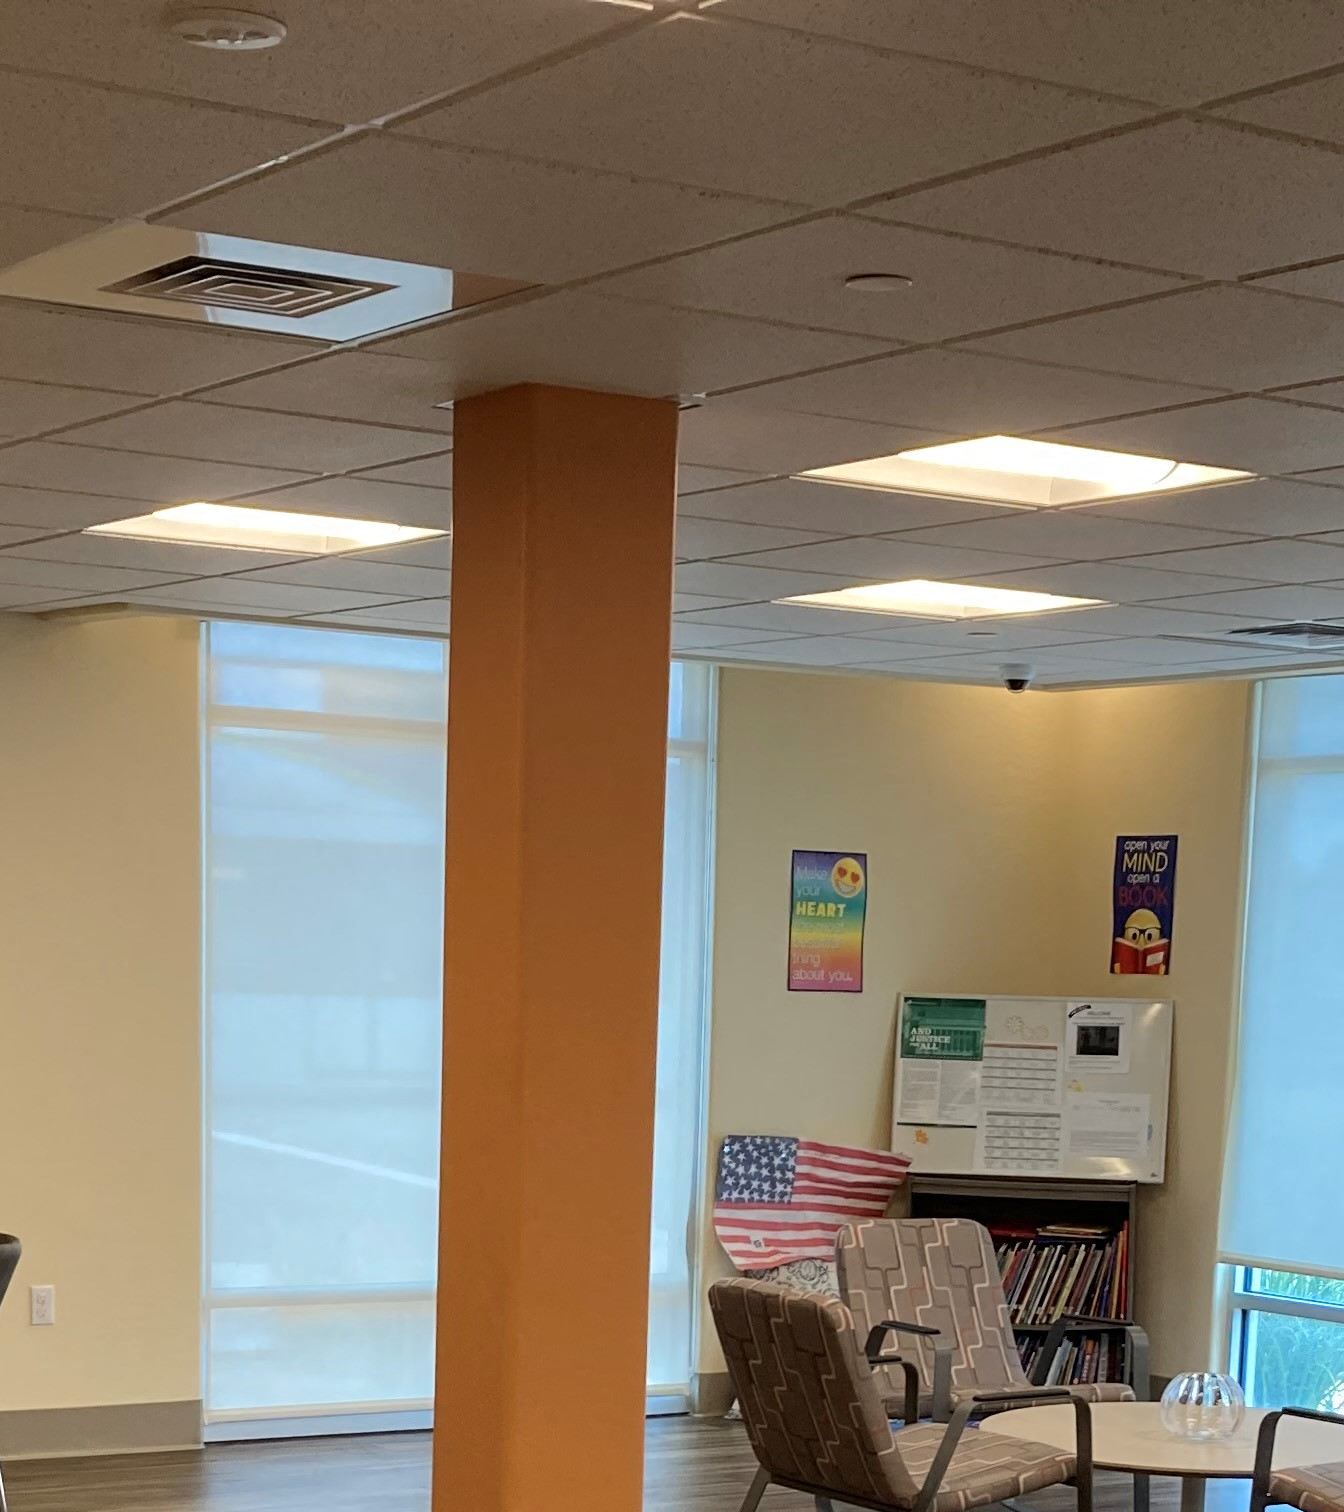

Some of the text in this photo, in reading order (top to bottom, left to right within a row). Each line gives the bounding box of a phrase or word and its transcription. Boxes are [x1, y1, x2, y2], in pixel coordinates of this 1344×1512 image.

[1124, 840, 1170, 852] open your
[1122, 852, 1169, 873] MIND
[796, 866, 828, 880] Make
[1127, 873, 1160, 885] open a
[796, 886, 821, 898] your
[1119, 886, 1168, 906] BOOK
[795, 901, 846, 918] HEART
[792, 969, 825, 981] about
[910, 1027, 932, 1035] AND
[909, 1035, 951, 1043] JUSTICE
